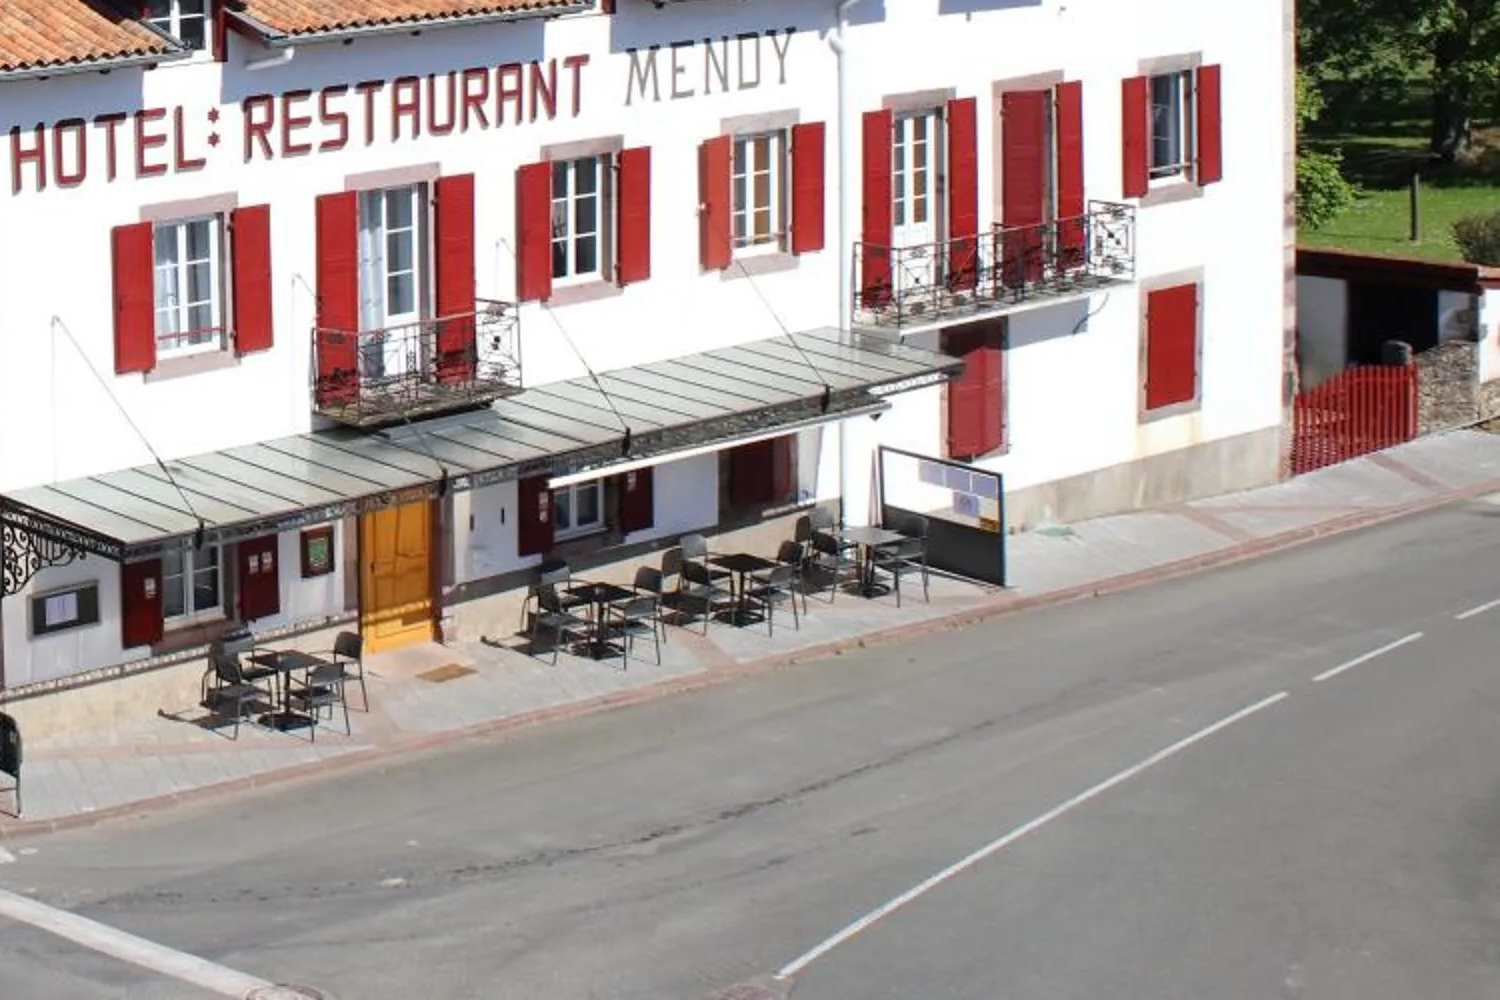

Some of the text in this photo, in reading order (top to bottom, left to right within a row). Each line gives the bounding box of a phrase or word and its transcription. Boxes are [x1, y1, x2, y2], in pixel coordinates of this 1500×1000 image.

[10, 26, 797, 196] HOTEL RESTAURANT MENDY
